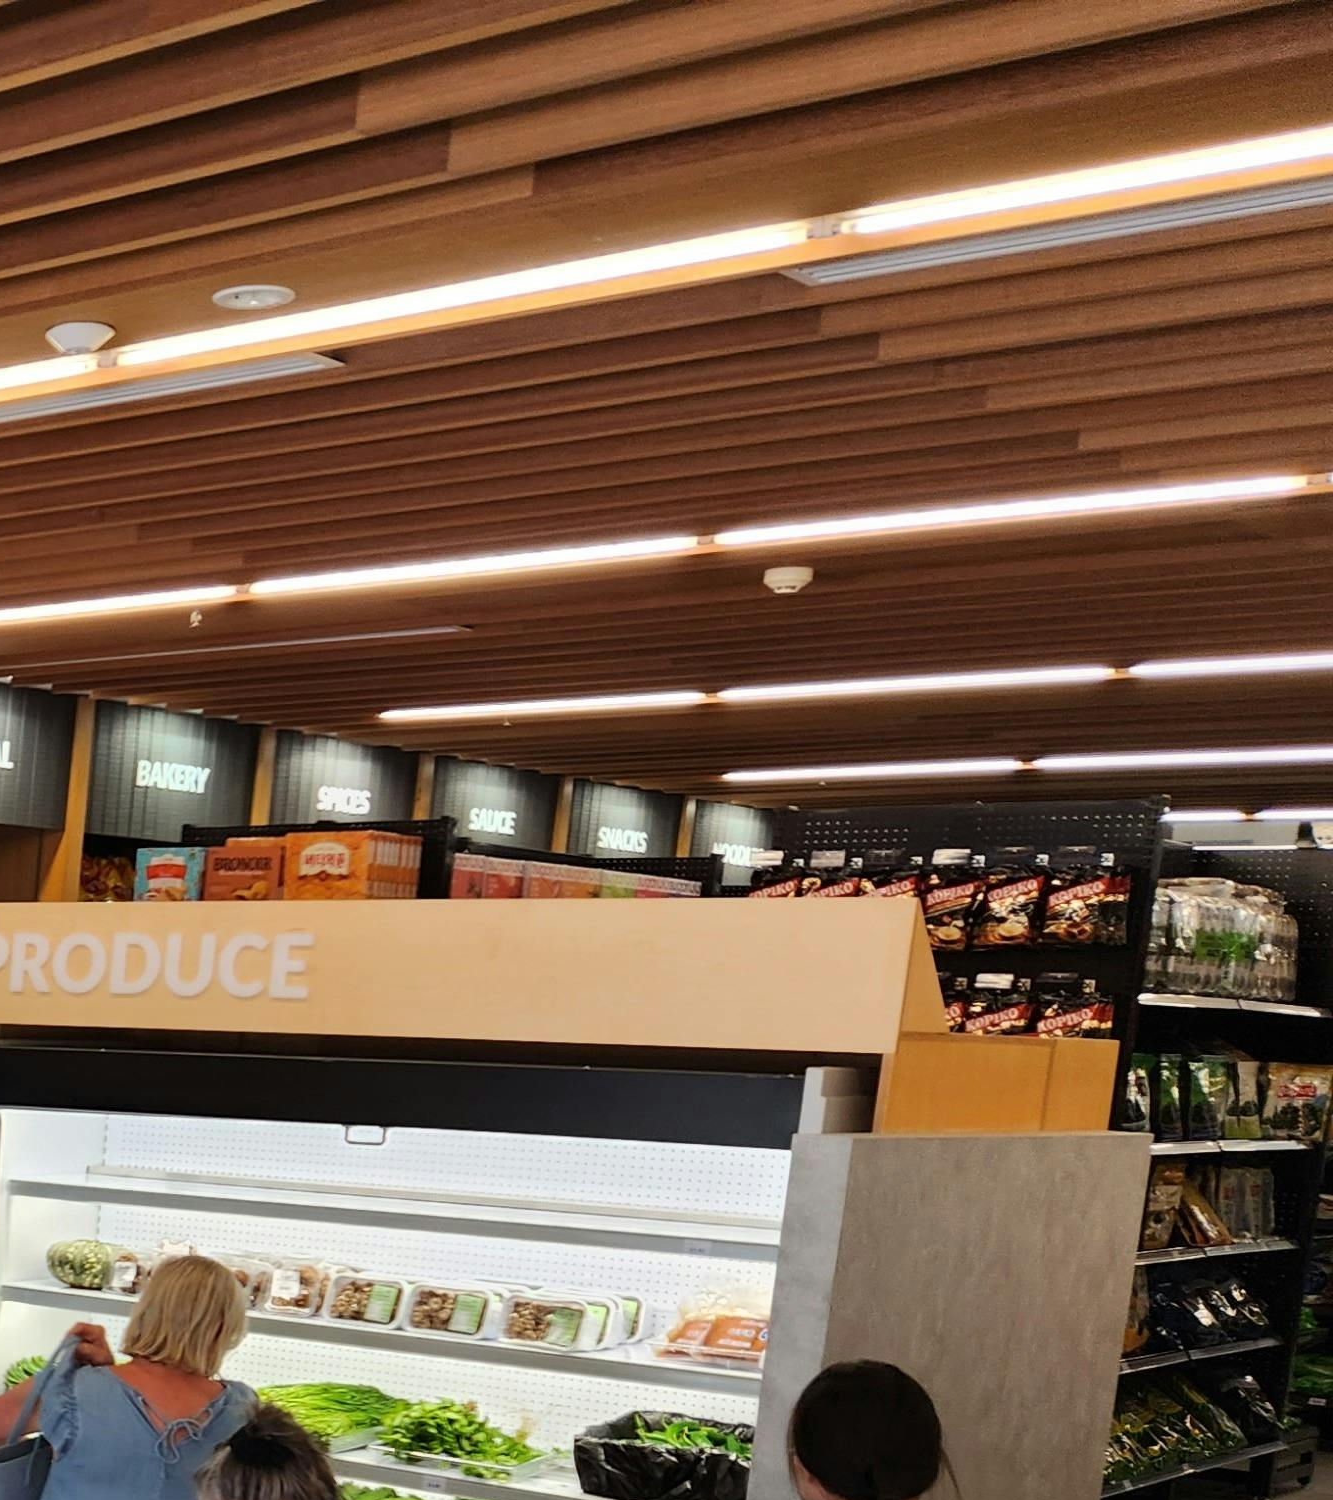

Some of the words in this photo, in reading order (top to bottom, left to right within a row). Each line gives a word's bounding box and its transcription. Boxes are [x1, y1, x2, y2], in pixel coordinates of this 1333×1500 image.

[135, 760, 211, 795] BAKERY
[316, 785, 372, 815] SPICES
[468, 807, 517, 836] SAUCE
[598, 825, 648, 855] SNACKS
[926, 882, 974, 906] KOPIKO
[987, 877, 1038, 902] KOPIKO
[1048, 880, 1104, 905] KOPIKO
[965, 1006, 1019, 1031] KOPIKO
[1037, 1007, 1093, 1032] KOPIKO
